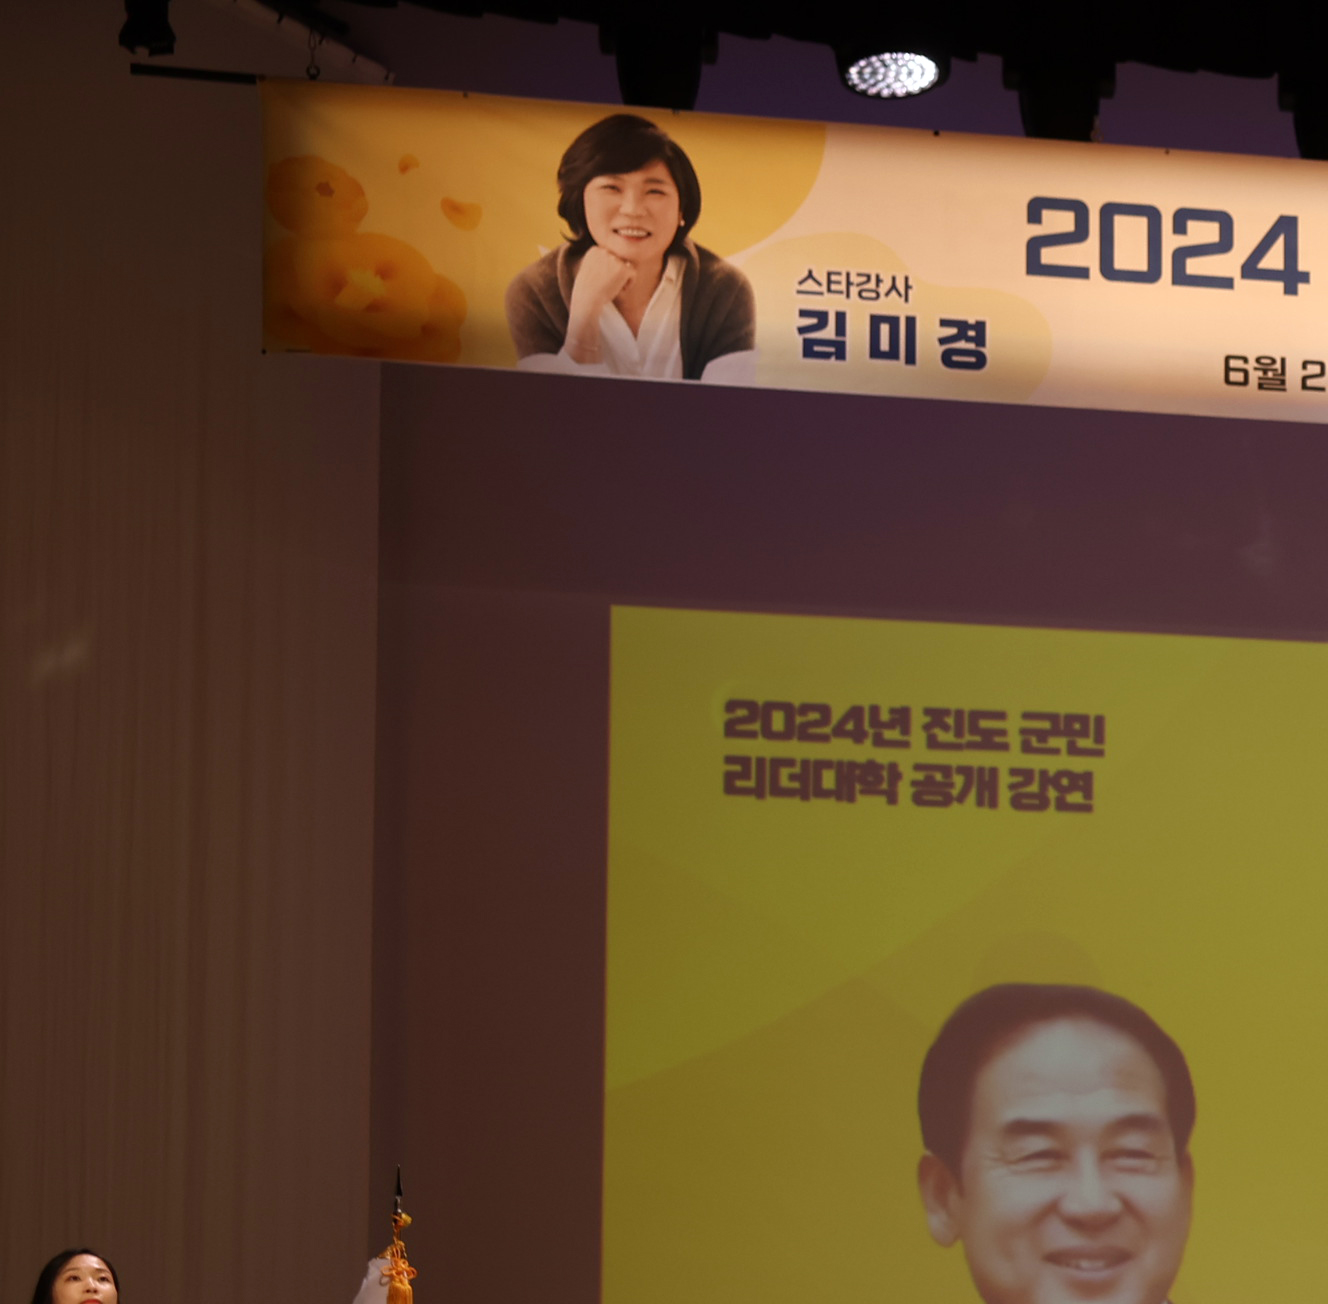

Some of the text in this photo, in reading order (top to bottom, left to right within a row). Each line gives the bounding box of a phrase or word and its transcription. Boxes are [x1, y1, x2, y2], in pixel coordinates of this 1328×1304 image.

[1025, 195, 1311, 297] 2024
[796, 268, 914, 304] 스타강사
[1223, 353, 1288, 393] 6월
[724, 697, 1106, 758] 2024년 진도 군민
[723, 754, 1095, 813] 리더대학 공개 강연
